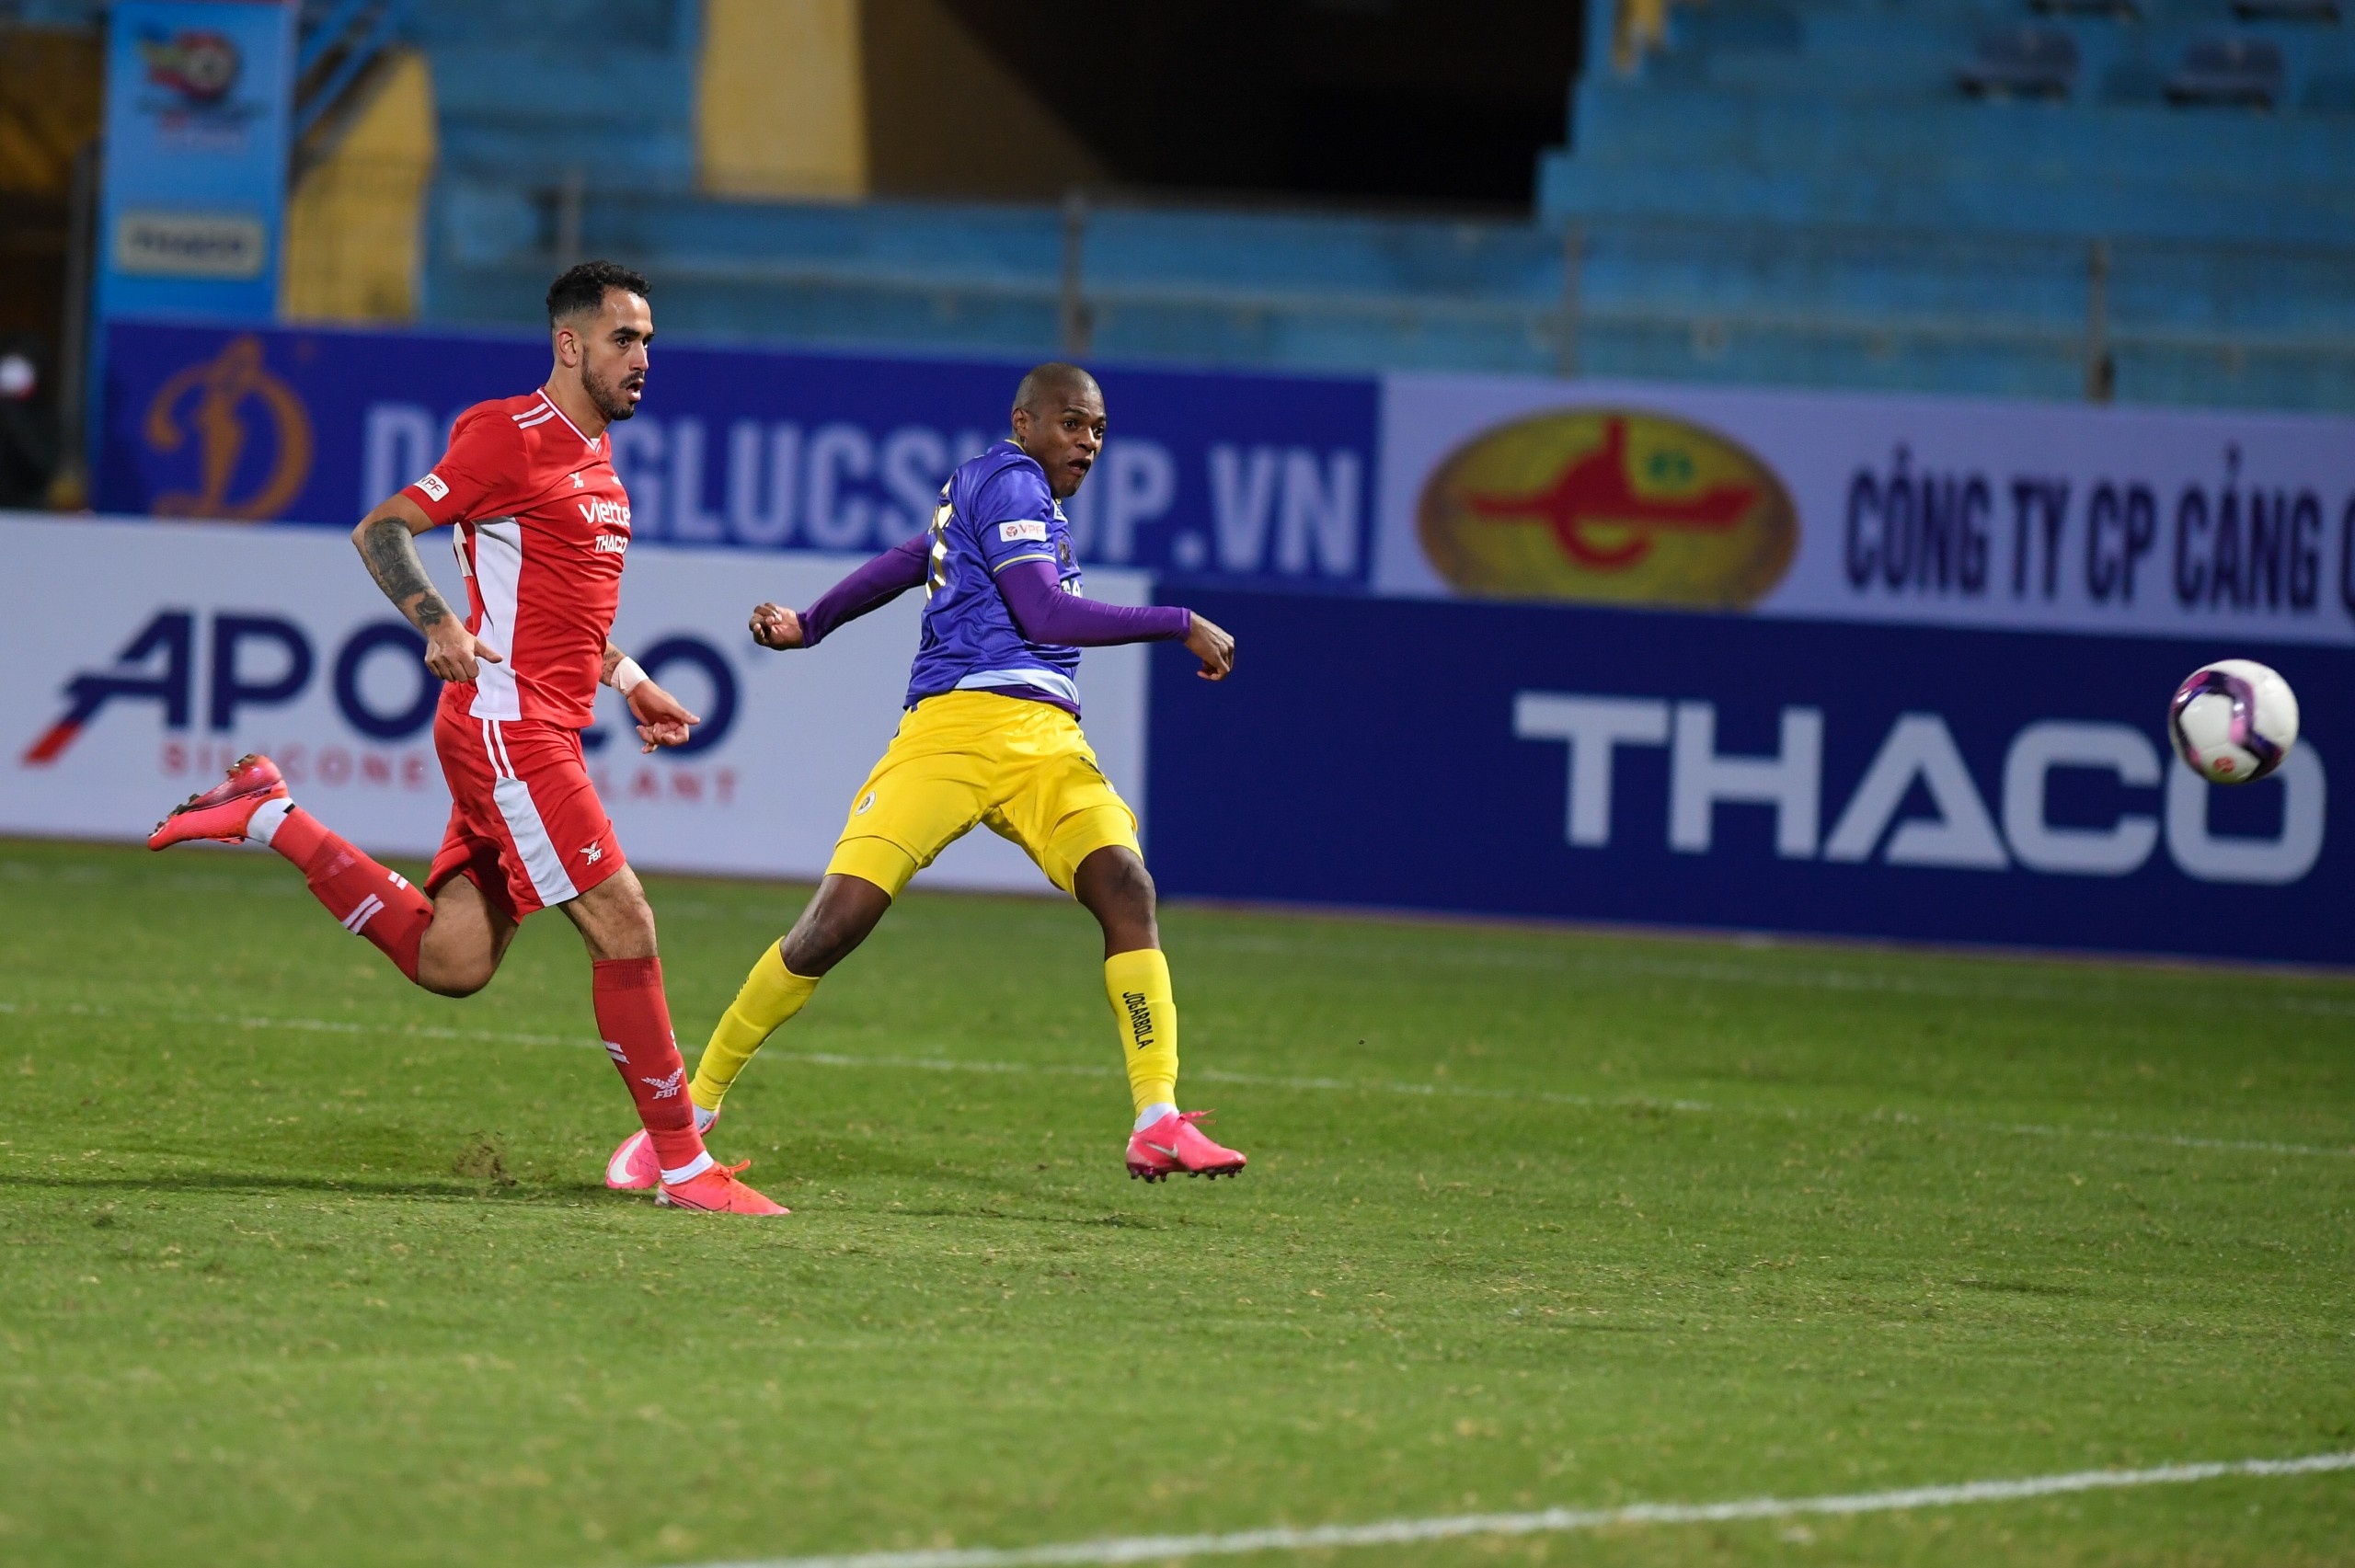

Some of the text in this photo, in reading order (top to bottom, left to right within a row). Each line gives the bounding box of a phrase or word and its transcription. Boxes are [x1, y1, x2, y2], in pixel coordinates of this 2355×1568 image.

[595, 534, 628, 555] THACO
[1019, 523, 1042, 534] VPF
[2009, 475, 2072, 603] TY
[2085, 478, 2158, 607] CP
[2173, 441, 2323, 614] CẢNG
[24, 610, 740, 766] APOO
[162, 741, 432, 789] SILCONE
[1513, 690, 2328, 887] THACO
[1122, 990, 1155, 1050] JOGARBOLA
[652, 1084, 682, 1100] FBT
